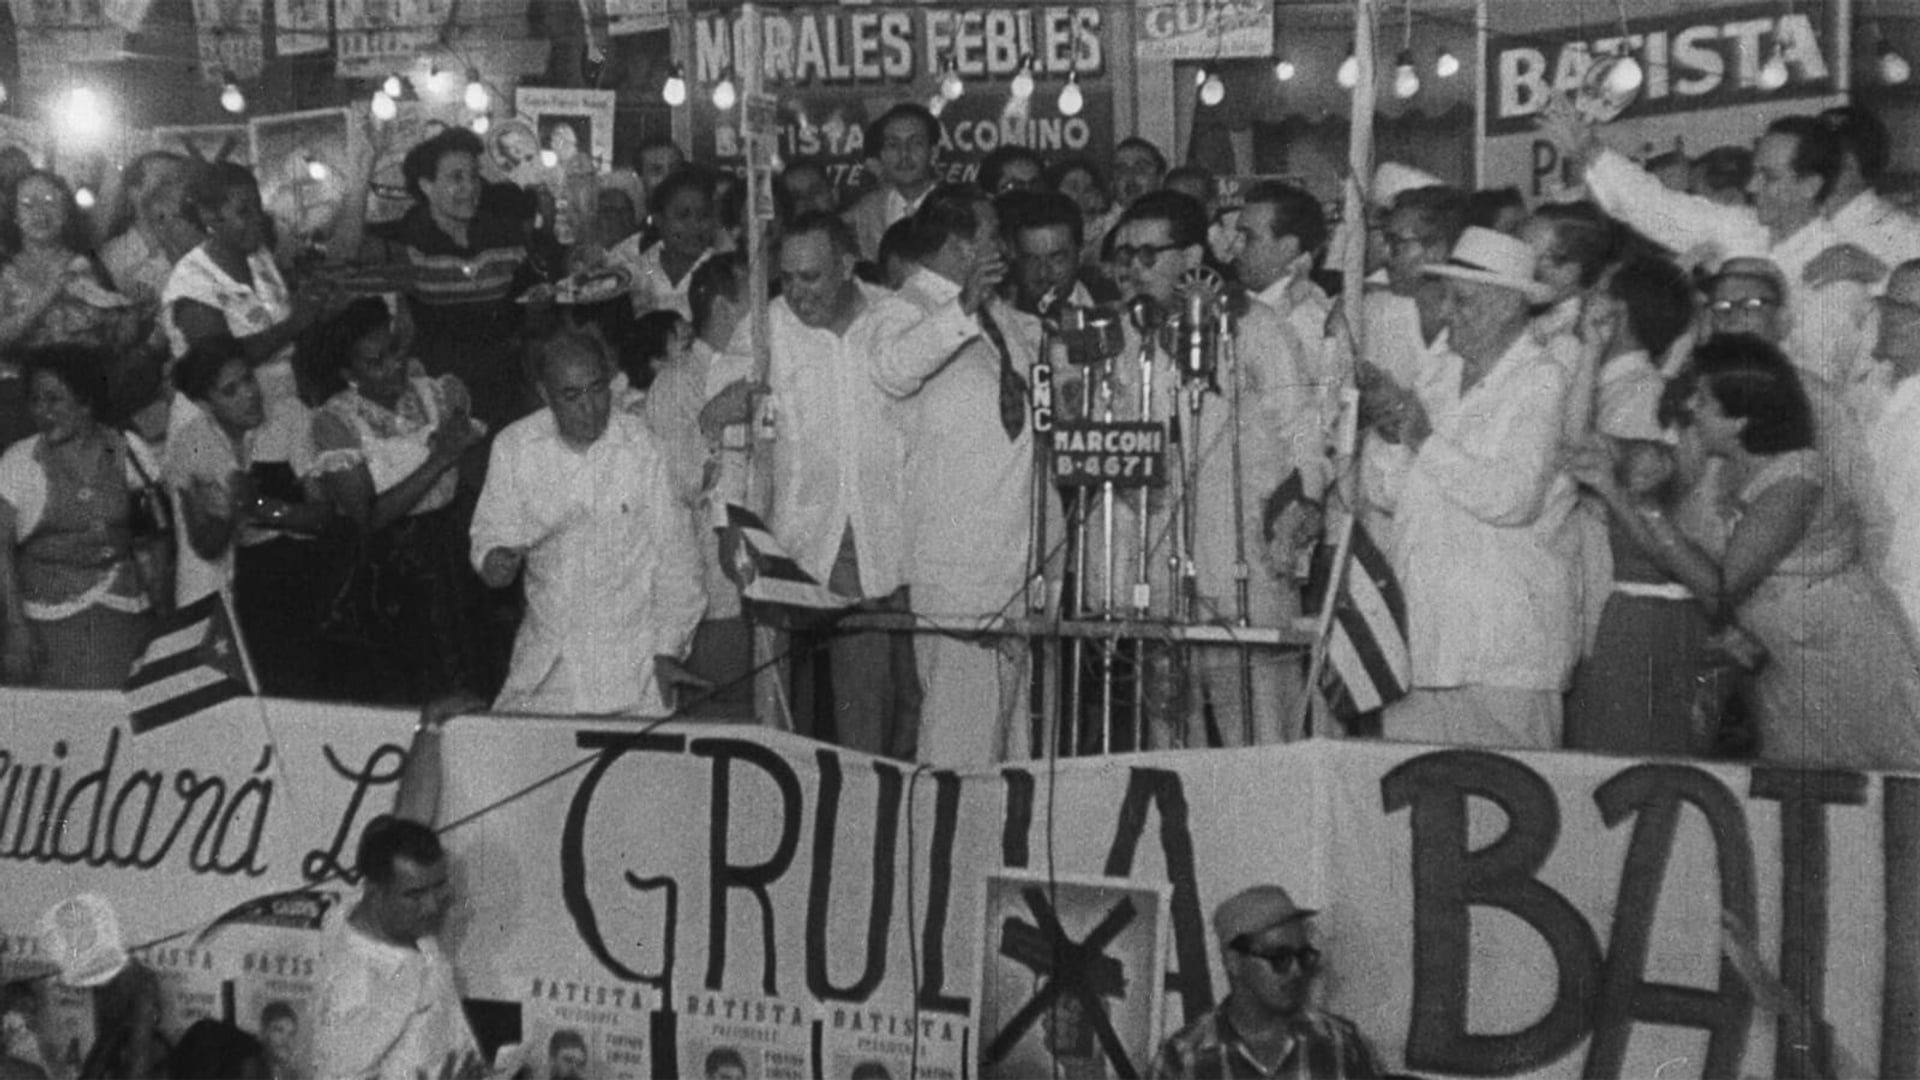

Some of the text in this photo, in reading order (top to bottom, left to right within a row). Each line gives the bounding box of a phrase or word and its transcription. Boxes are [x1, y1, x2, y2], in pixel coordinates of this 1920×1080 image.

[926, 7, 1100, 73] FEBLES
[715, 117, 1090, 157] BISTA ACOMINO
[1054, 430, 1162, 453] MARCONI
[0, 727, 408, 885] uidará L
[243, 952, 314, 976] BATIS
[531, 979, 643, 1011] BATISTA
[686, 995, 803, 1028] BATISTA
[832, 1008, 953, 1041] BATISTA
